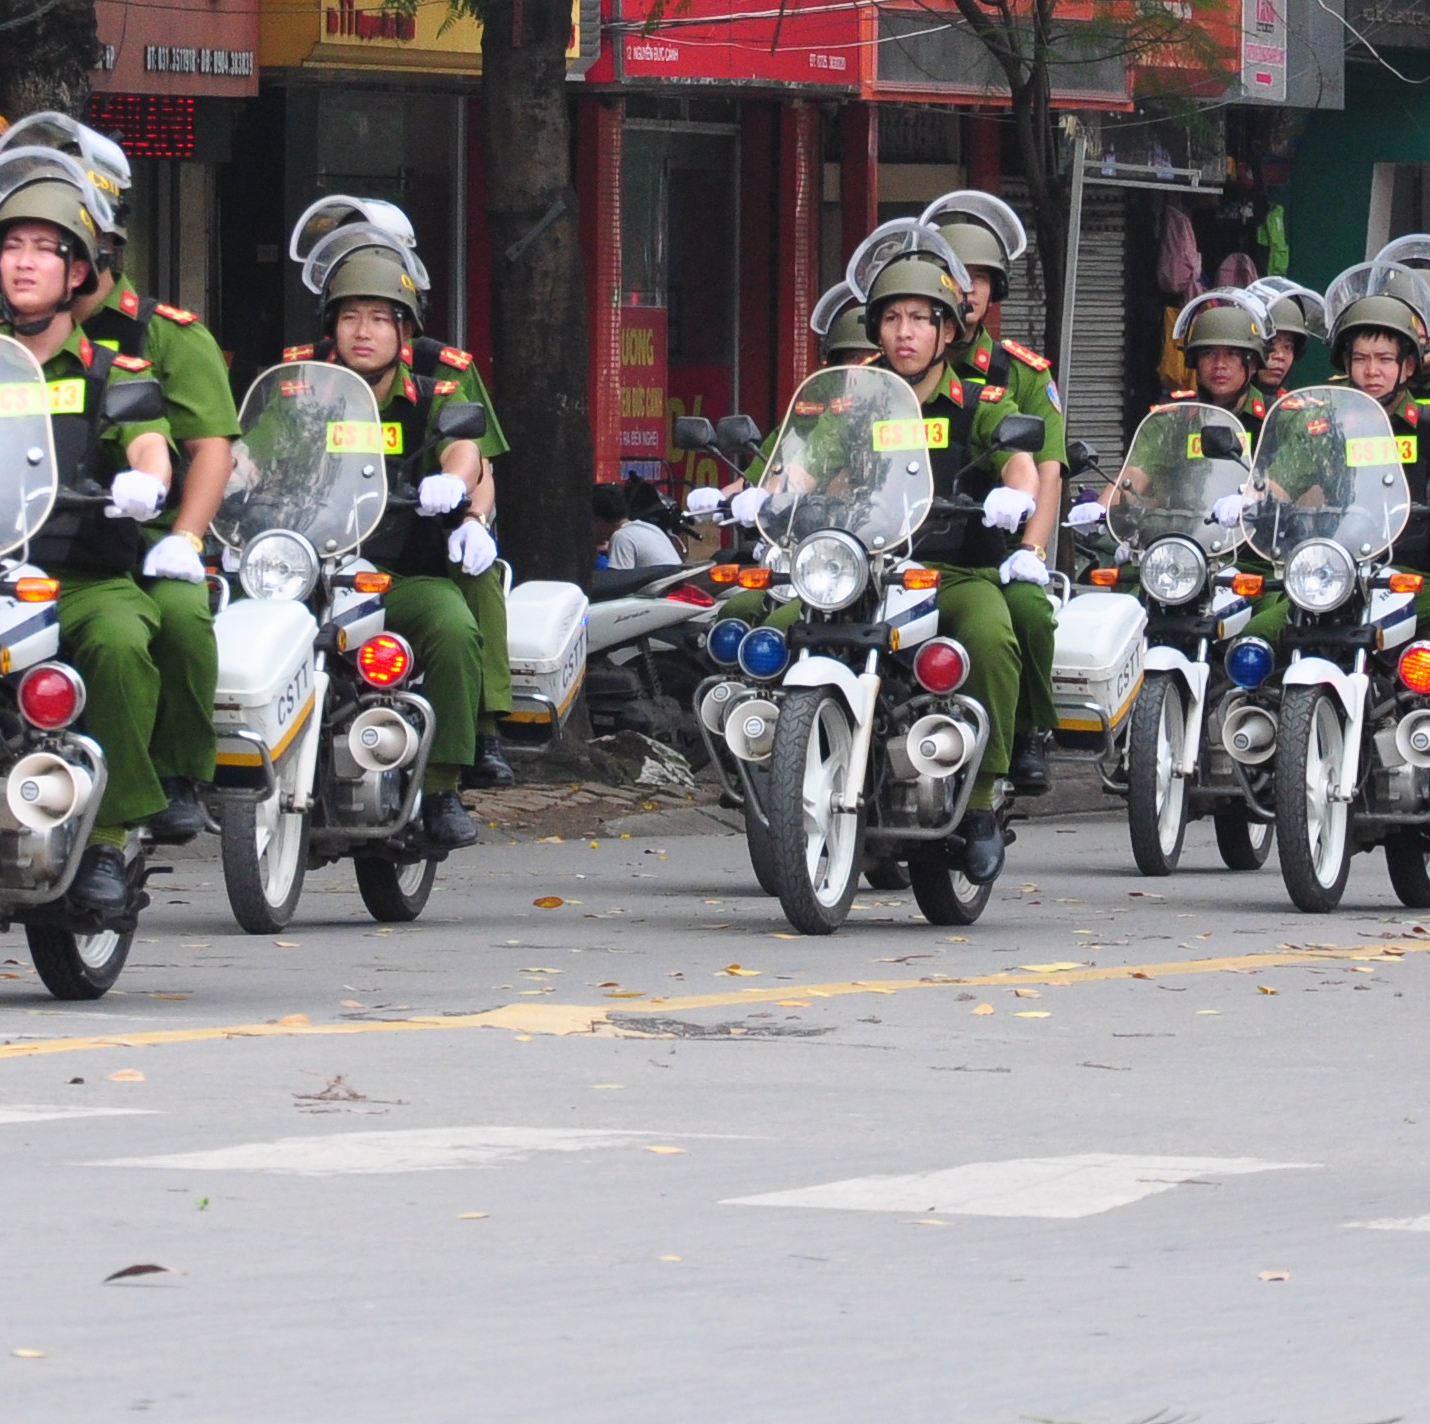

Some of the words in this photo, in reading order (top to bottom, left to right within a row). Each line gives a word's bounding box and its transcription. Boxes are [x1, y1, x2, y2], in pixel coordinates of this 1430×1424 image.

[0, 388, 29, 410] CS
[332, 425, 357, 446] CS
[366, 425, 398, 448] 13
[879, 425, 903, 446] CS
[1351, 445, 1374, 461] CS
[1381, 441, 1412, 459] 13
[562, 631, 584, 689] CSTT
[1117, 641, 1141, 699] CSTT
[277, 660, 308, 726] CSTT
